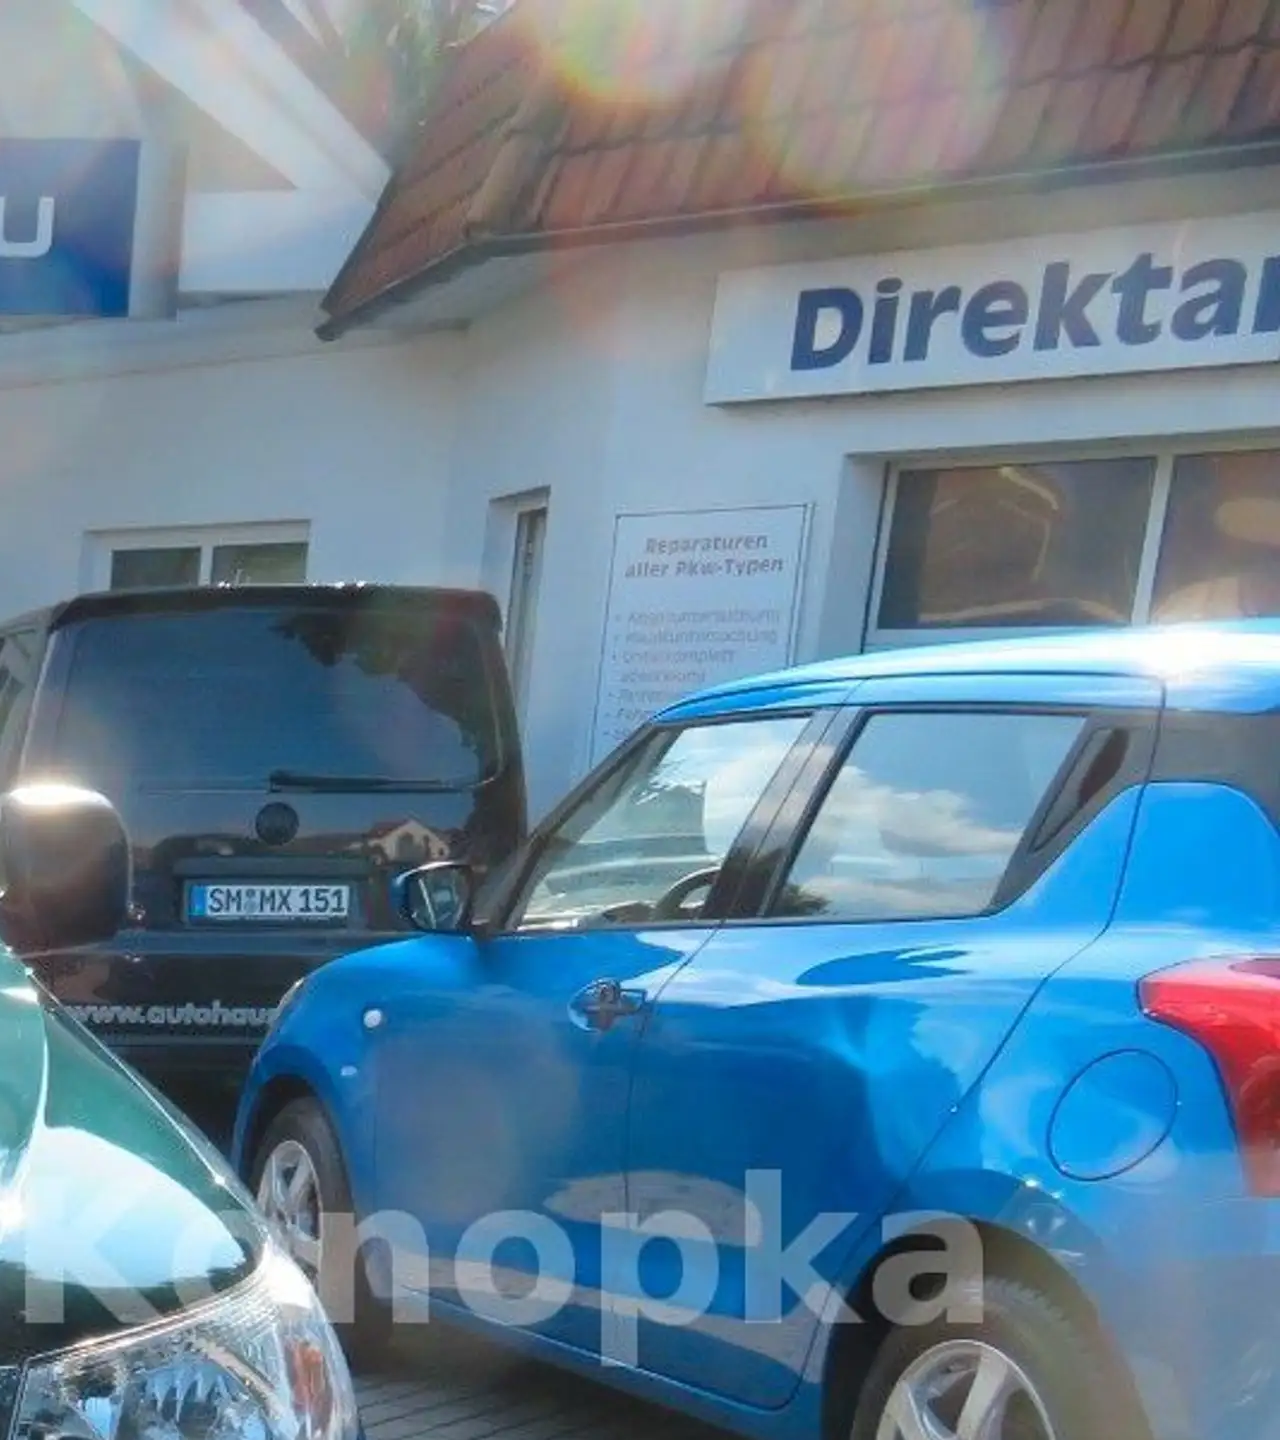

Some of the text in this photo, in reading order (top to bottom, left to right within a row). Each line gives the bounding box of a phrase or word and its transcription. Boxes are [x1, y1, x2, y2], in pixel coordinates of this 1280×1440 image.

[646, 535, 768, 555] Reparaturen
[625, 560, 669, 578] aller
[298, 887, 346, 912] 151
